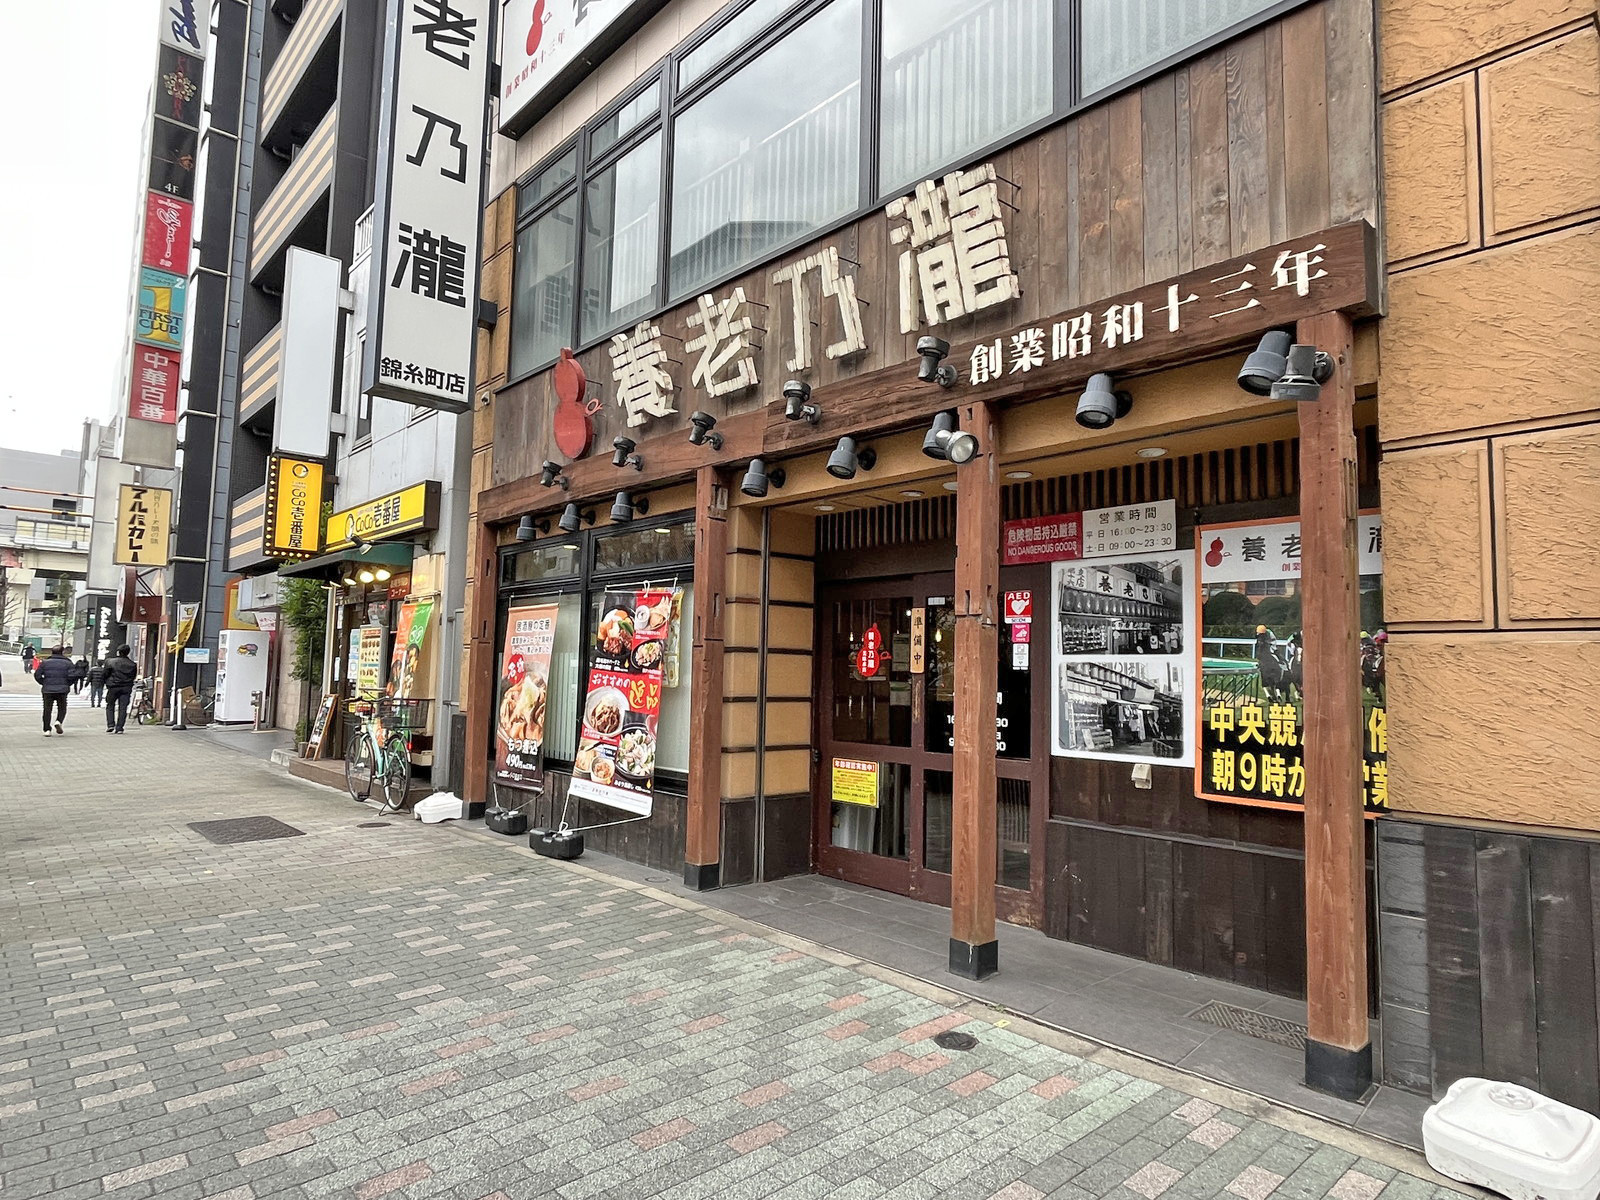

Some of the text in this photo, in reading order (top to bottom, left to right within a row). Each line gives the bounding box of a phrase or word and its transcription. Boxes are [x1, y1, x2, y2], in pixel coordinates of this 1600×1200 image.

[164, 182, 179, 194] 4F
[608, 163, 1021, 429] 養老乃瀧
[139, 309, 182, 327] FIRST
[969, 243, 1329, 386] 創業昭和十三年
[138, 318, 179, 336] CLUB
[380, 356, 466, 395] 錦糸町店
[138, 352, 168, 421] 中華百番
[1099, 506, 1157, 525] 営業時間
[1008, 522, 1077, 543] 危険物品持込厳禁
[1086, 529, 1105, 539] 平日
[1008, 541, 1077, 556] NO DANGEROUS GOODS
[1008, 592, 1030, 600] AED
[592, 673, 631, 688] おすすめの
[1210, 700, 1388, 754] 中央競催
